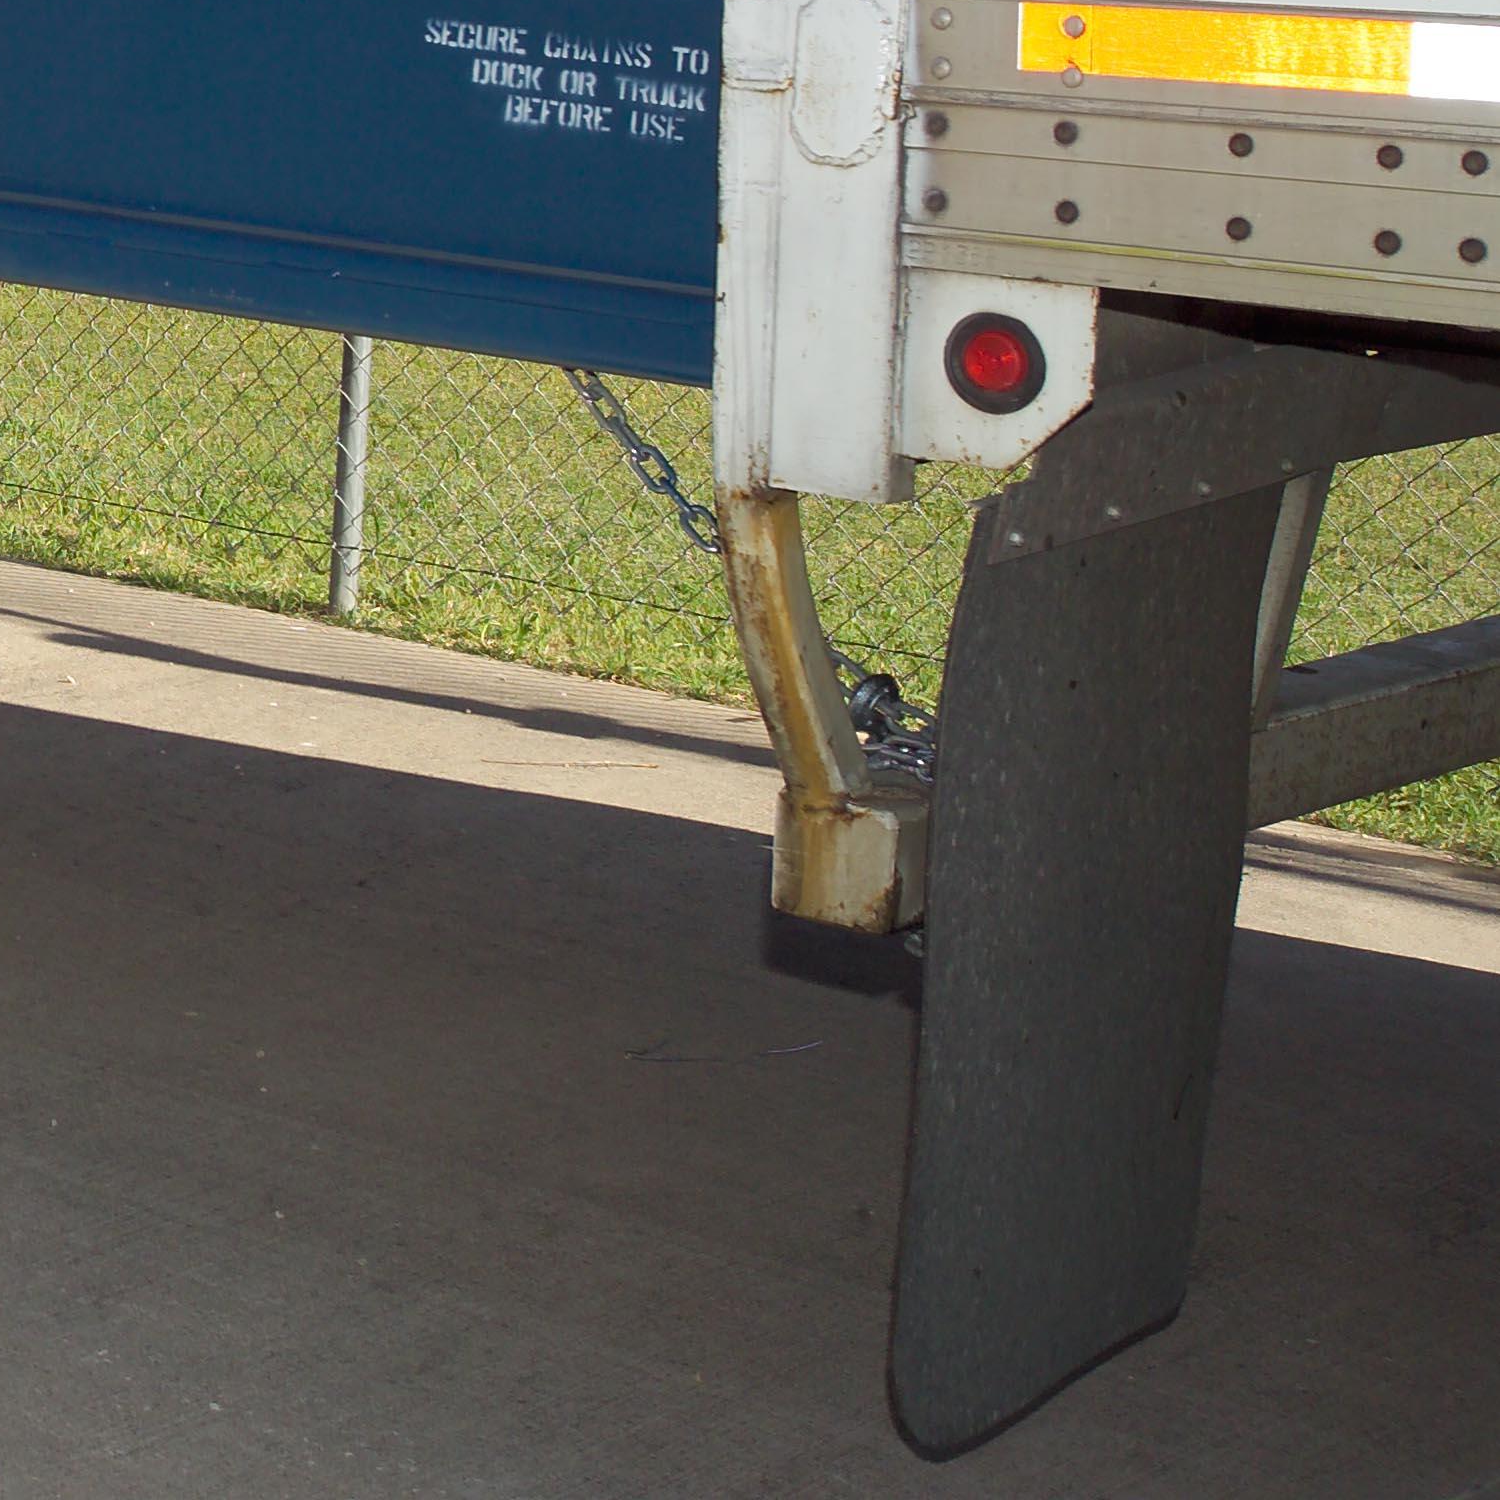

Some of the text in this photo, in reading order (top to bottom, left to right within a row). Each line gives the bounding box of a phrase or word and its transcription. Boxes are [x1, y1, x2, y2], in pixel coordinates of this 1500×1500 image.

[424, 18, 710, 76] SECURE CHAINS TO
[472, 58, 706, 112] DOCK OR TRUCK
[504, 94, 687, 142] BEFORE USE
